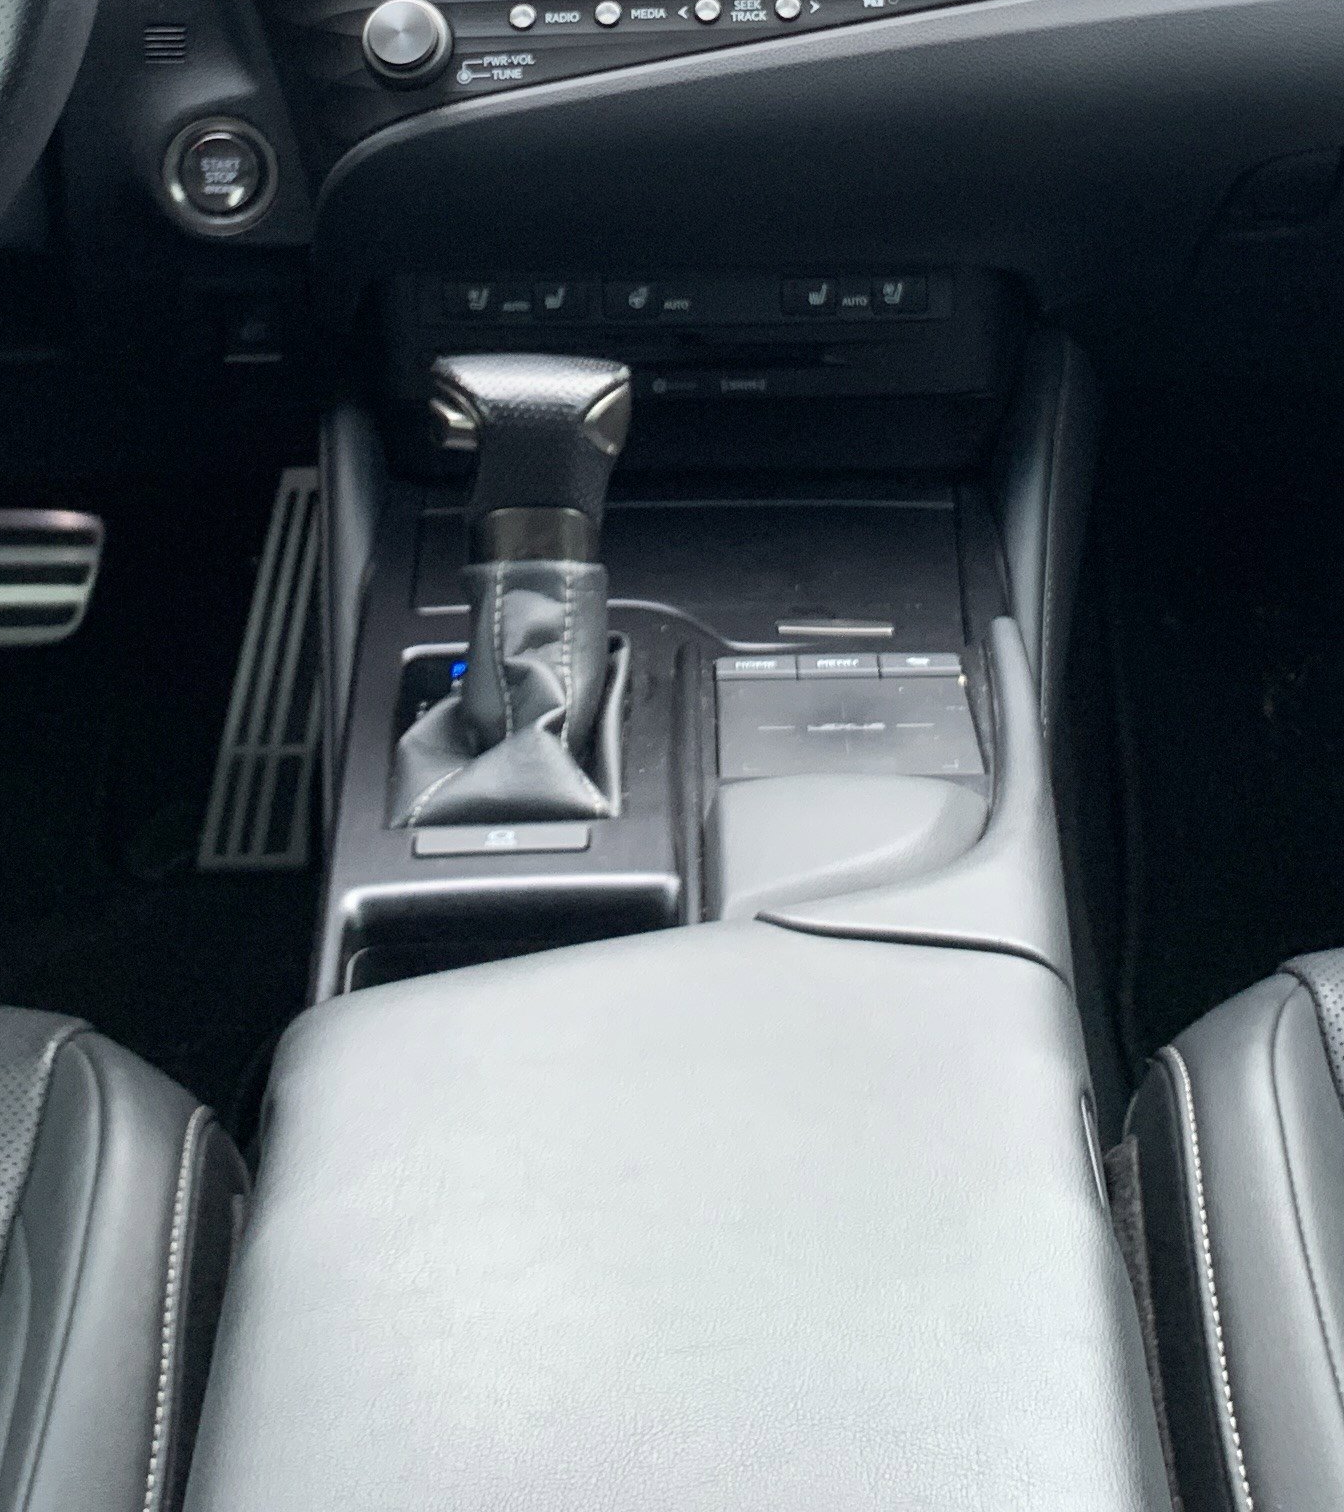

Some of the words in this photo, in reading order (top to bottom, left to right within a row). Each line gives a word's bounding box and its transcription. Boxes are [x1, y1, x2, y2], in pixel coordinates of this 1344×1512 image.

[734, 0, 761, 10] SEEK
[544, 12, 580, 23] RADIO
[631, 8, 666, 19] MEDIA
[731, 11, 767, 22] TRACK
[492, 69, 523, 80] TUNE
[664, 300, 689, 310] AUTO
[842, 296, 868, 307] AUTO
